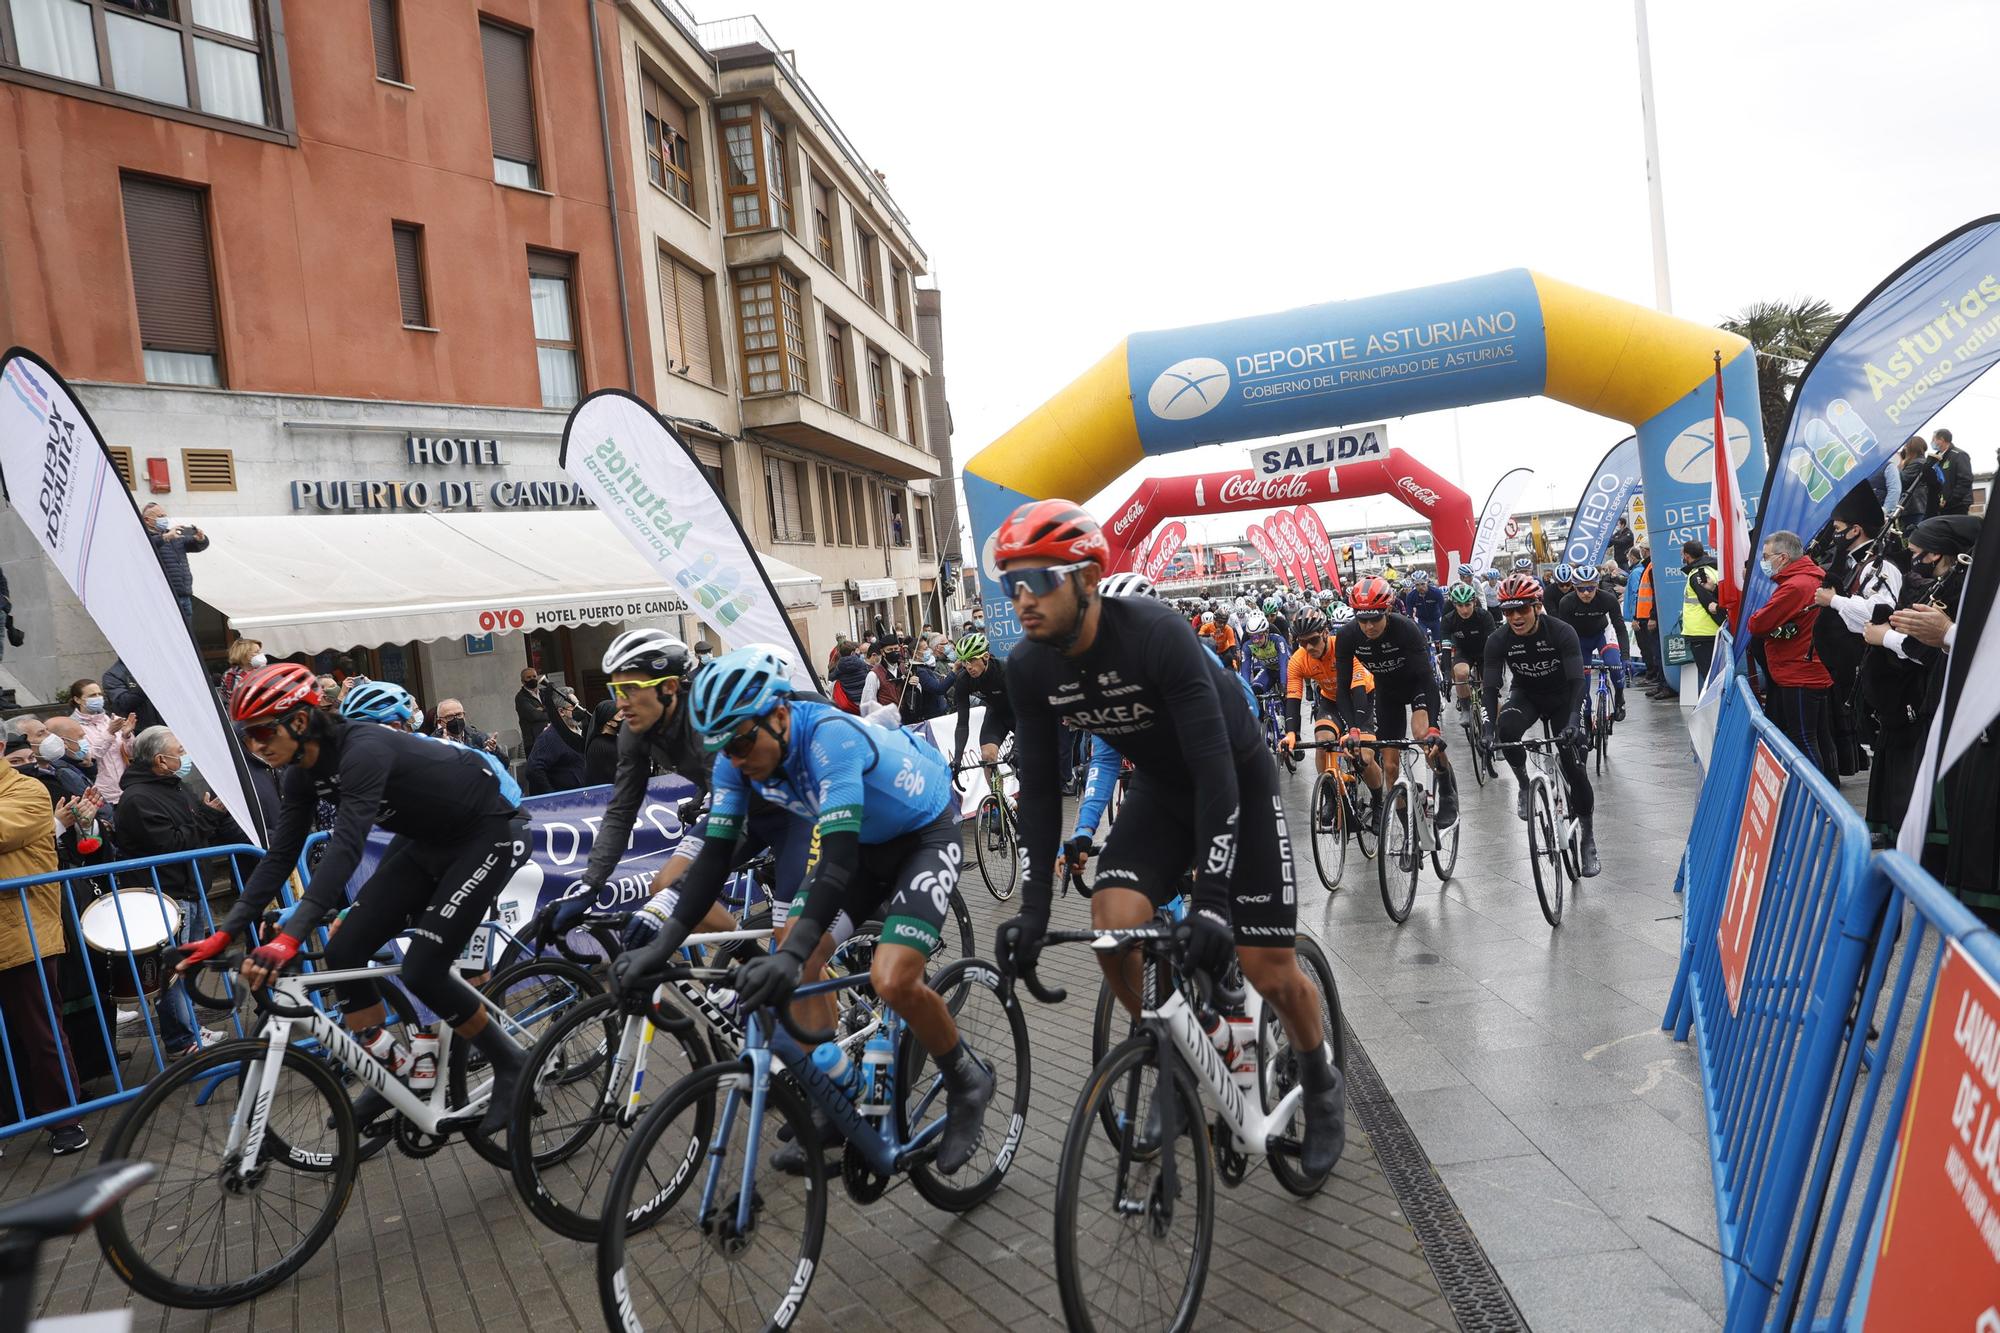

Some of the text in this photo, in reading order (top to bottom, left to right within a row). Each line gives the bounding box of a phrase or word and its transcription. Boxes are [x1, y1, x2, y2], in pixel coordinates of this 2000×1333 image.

[1236, 311, 1517, 378] DEPORTE ASTURIANO
[1864, 274, 2000, 401] Asturias
[1314, 375, 1338, 388] DEL
[1422, 357, 1440, 370] DE
[1444, 344, 1514, 368] ASTURIAS
[407, 436, 511, 466] HOTEL
[1262, 431, 1380, 474] SALIDA
[290, 480, 597, 510] PUERTO DE CANDA
[1569, 473, 1620, 563] OVIEDO
[479, 597, 689, 631] OYO HOTEL PUERTO DE CANDÁS
[1512, 658, 1560, 672] ARKEA
[1062, 702, 1155, 727] ARKEA
[1271, 795, 1295, 905] SAMSIC
[440, 852, 499, 919] SAMSIC
[504, 910, 518, 924] 51
[471, 934, 487, 961] 132
[311, 1014, 387, 1092] CANYON
[1187, 1012, 1245, 1128] CANYON
[790, 1055, 863, 1131] AURUM
[1951, 1071, 1982, 1145] DE
